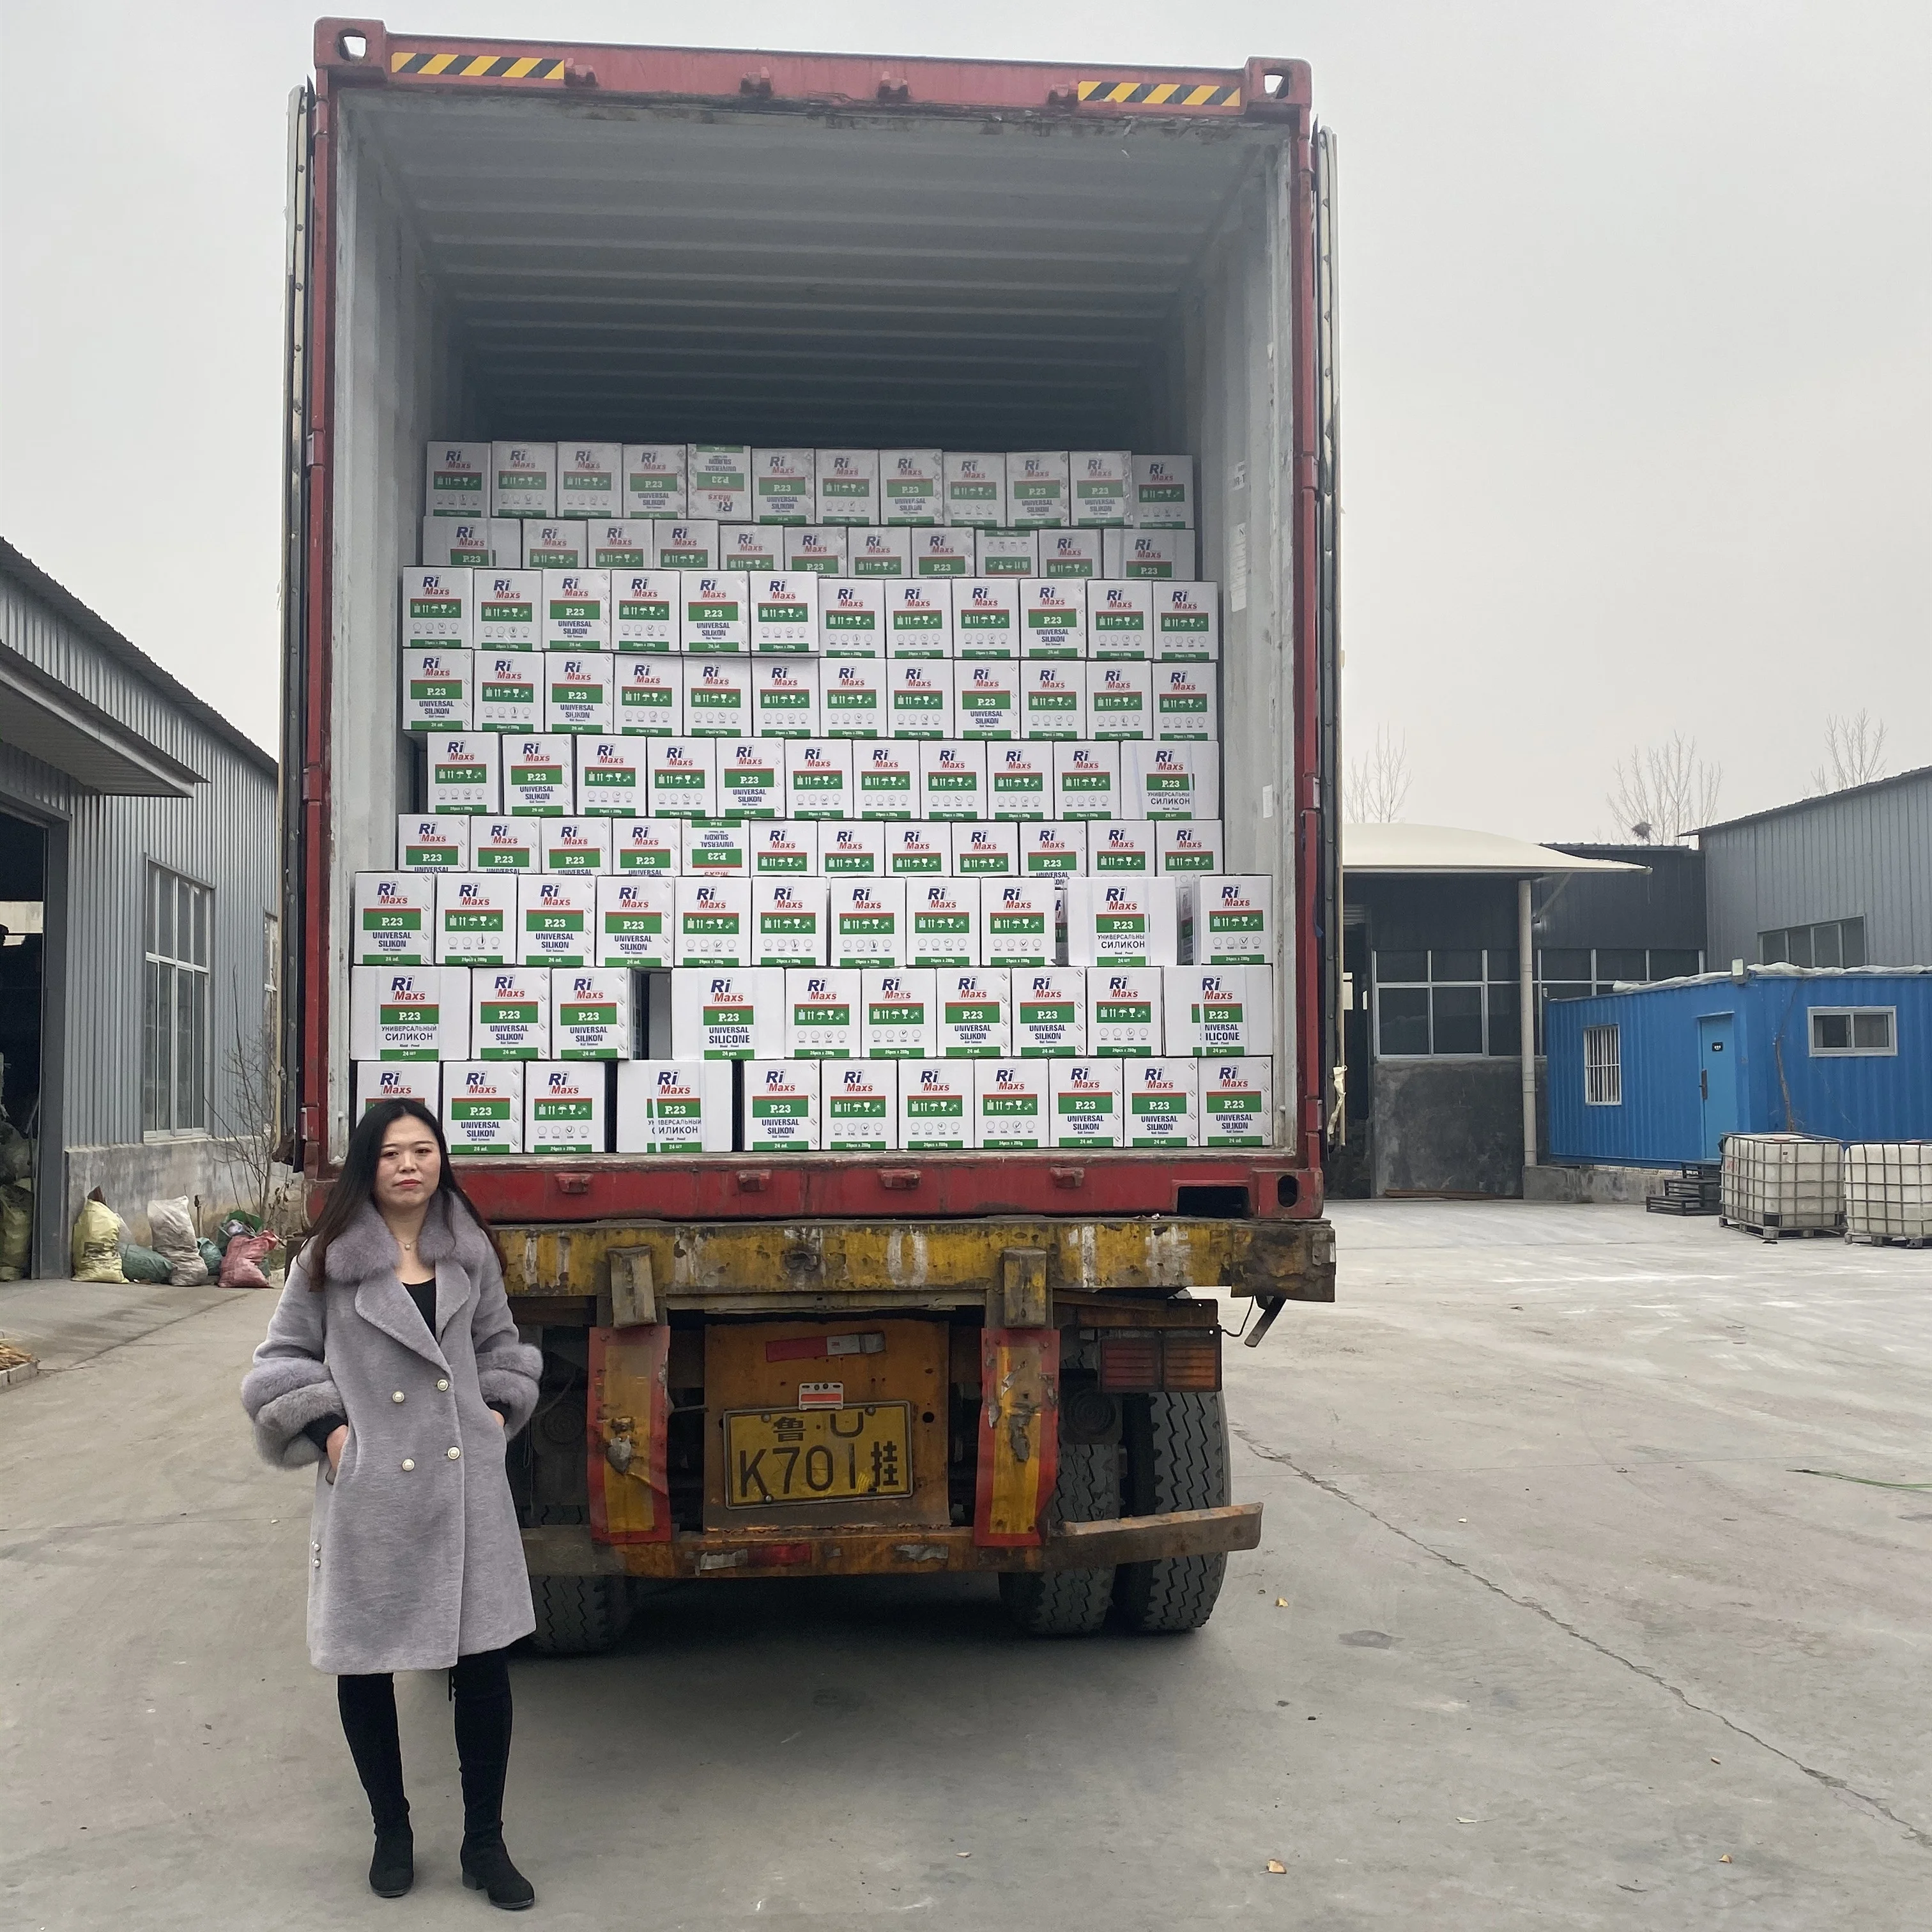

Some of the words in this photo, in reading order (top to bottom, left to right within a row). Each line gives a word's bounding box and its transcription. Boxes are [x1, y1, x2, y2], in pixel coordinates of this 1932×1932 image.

[770, 456, 785, 467] Ri
[1025, 459, 1040, 470] Ri
[456, 526, 473, 538] Ri
[459, 537, 485, 546] Maxs
[1135, 539, 1151, 550] Ri
[1137, 549, 1162, 558] Maxs
[562, 578, 578, 588] Ri
[565, 588, 588, 597] Maxs
[1039, 587, 1055, 598] Ri
[423, 658, 439, 668] Ri
[974, 670, 989, 679] Ri
[523, 744, 539, 755] Ri
[1156, 751, 1172, 762] Ri
[1158, 762, 1184, 770] Maxs
[1162, 779, 1180, 788] P.23
[419, 823, 436, 834] Ri
[378, 884, 396, 896] Ri
[540, 885, 559, 897] Ri
[619, 887, 637, 899] Ri
[1106, 888, 1124, 901] Ri
[381, 896, 406, 904] Maxs
[544, 897, 570, 905] Maxs
[622, 899, 648, 908] Maxs
[1109, 901, 1135, 910] Maxs
[382, 917, 402, 926] P.23
[544, 919, 565, 927] P.23
[624, 921, 644, 930] P.23
[392, 977, 412, 990] Ri
[494, 977, 513, 988] Ri
[574, 979, 592, 990] Ri
[711, 981, 730, 992] Ri
[958, 978, 976, 990] Ri
[1033, 978, 1050, 990] Ri
[1202, 977, 1220, 990] Ri
[395, 992, 424, 1000] Maxs
[498, 988, 523, 997] Maxs
[577, 990, 602, 999] Maxs
[1206, 991, 1232, 1000] Maxs
[715, 993, 742, 1002] Maxs
[399, 1012, 420, 1020] P.23
[499, 1011, 520, 1019] P.23
[578, 1012, 599, 1021] P.23
[719, 1013, 739, 1022] P.23
[1038, 1011, 1057, 1019] P.23
[1209, 1011, 1229, 1019] P.23
[709, 1035, 750, 1043] SILICONE
[1199, 1032, 1240, 1041] ILICONE
[766, 1071, 784, 1083] Ri
[1071, 1068, 1088, 1080] Ri
[1145, 1069, 1162, 1081] Ri
[1220, 1068, 1237, 1079] Ri
[466, 1073, 485, 1085] Ri
[657, 1072, 678, 1085] Ri
[1222, 1079, 1247, 1087] Maxs
[1074, 1080, 1099, 1088] Maxs
[661, 1085, 689, 1094] Maxs
[1149, 1101, 1169, 1110] P.23
[1224, 1100, 1244, 1108] P.23
[470, 1107, 491, 1116] P.23
[664, 1105, 686, 1114] P.23
[770, 1105, 791, 1113] P.23
